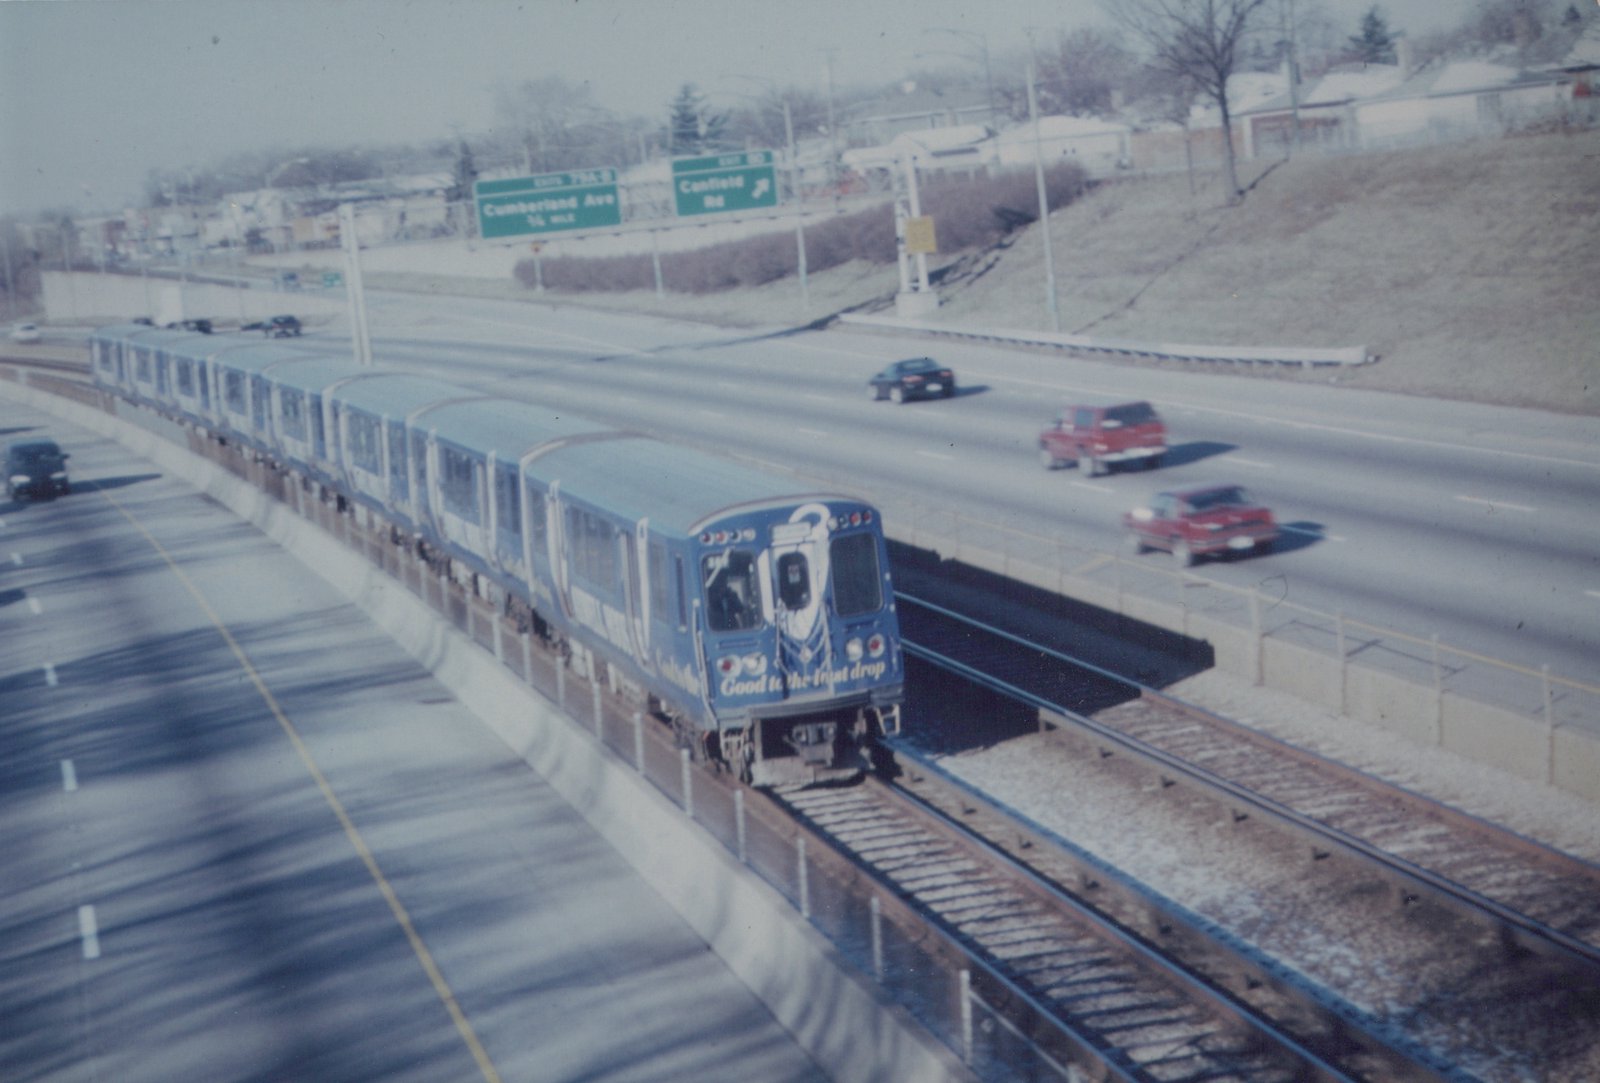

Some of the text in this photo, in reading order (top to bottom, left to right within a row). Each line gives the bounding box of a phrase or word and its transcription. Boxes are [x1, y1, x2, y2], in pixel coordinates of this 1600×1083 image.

[484, 194, 614, 216] Cumberland Ave
[720, 674, 767, 696] Good
[850, 661, 886, 681] drop
